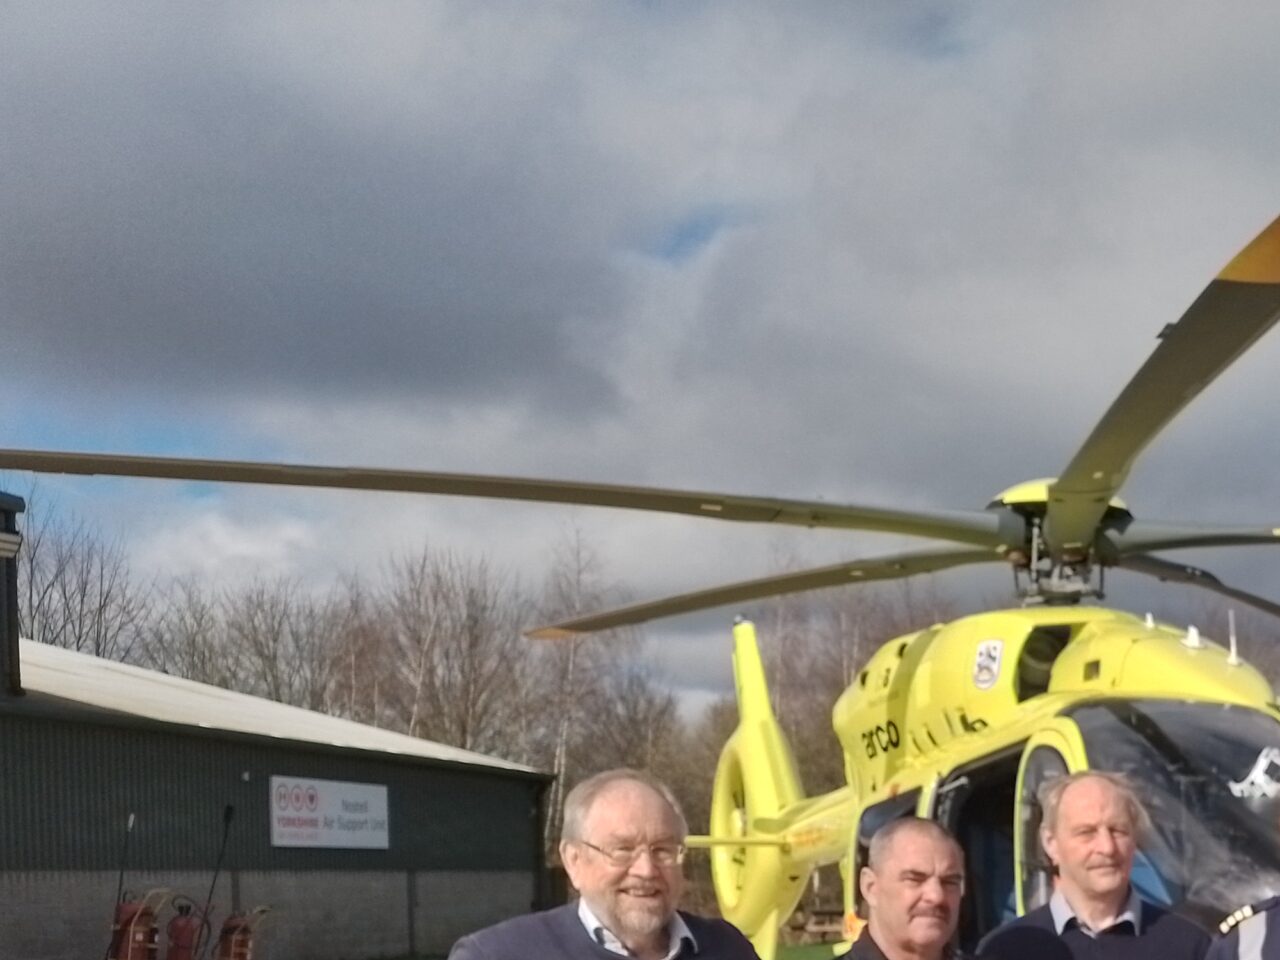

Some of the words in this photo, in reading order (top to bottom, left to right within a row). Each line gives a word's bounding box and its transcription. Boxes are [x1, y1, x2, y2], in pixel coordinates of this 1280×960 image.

[861, 720, 900, 759] arco
[323, 815, 335, 829] Air
[337, 815, 369, 831] Support
